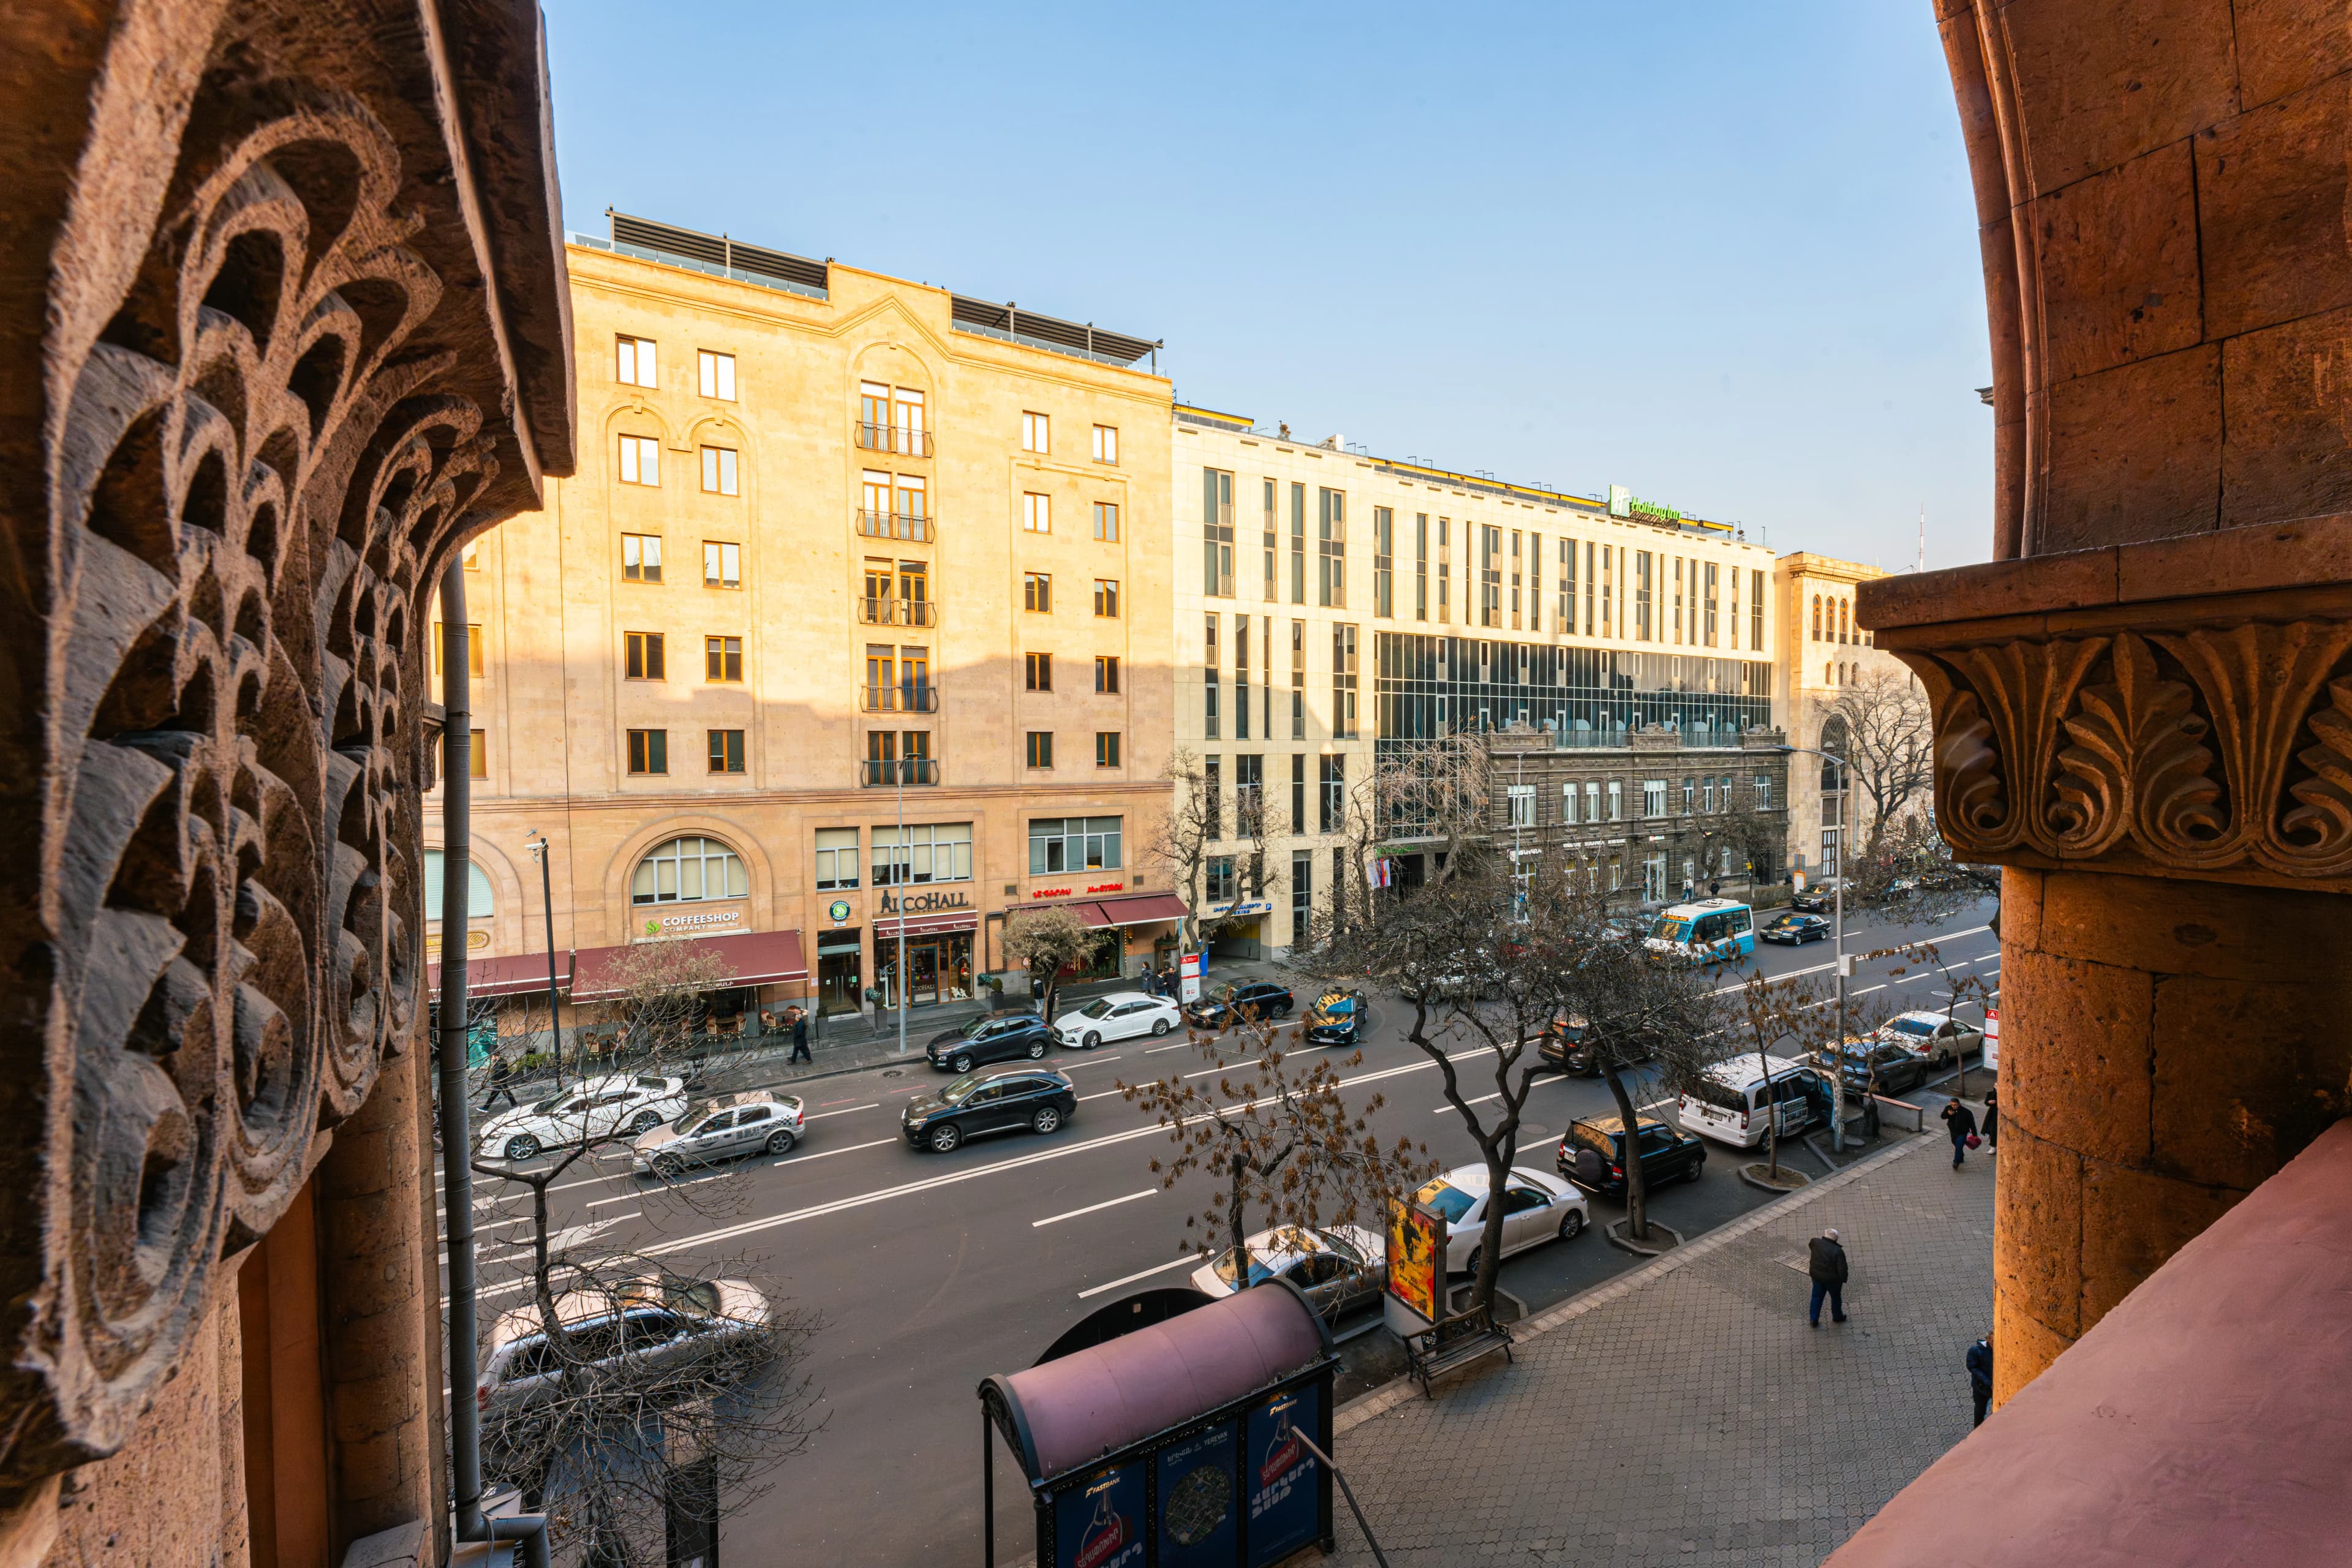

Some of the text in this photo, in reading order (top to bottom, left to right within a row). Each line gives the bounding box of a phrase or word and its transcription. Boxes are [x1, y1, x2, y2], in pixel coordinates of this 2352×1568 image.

[1631, 497, 1681, 520] Holiday Inn
[663, 912, 739, 927] COFFEESHOP
[663, 924, 706, 933] COMPANY
[1204, 1430, 1228, 1446] YEREVAN
[1093, 1476, 1121, 1494] FASTBANK
